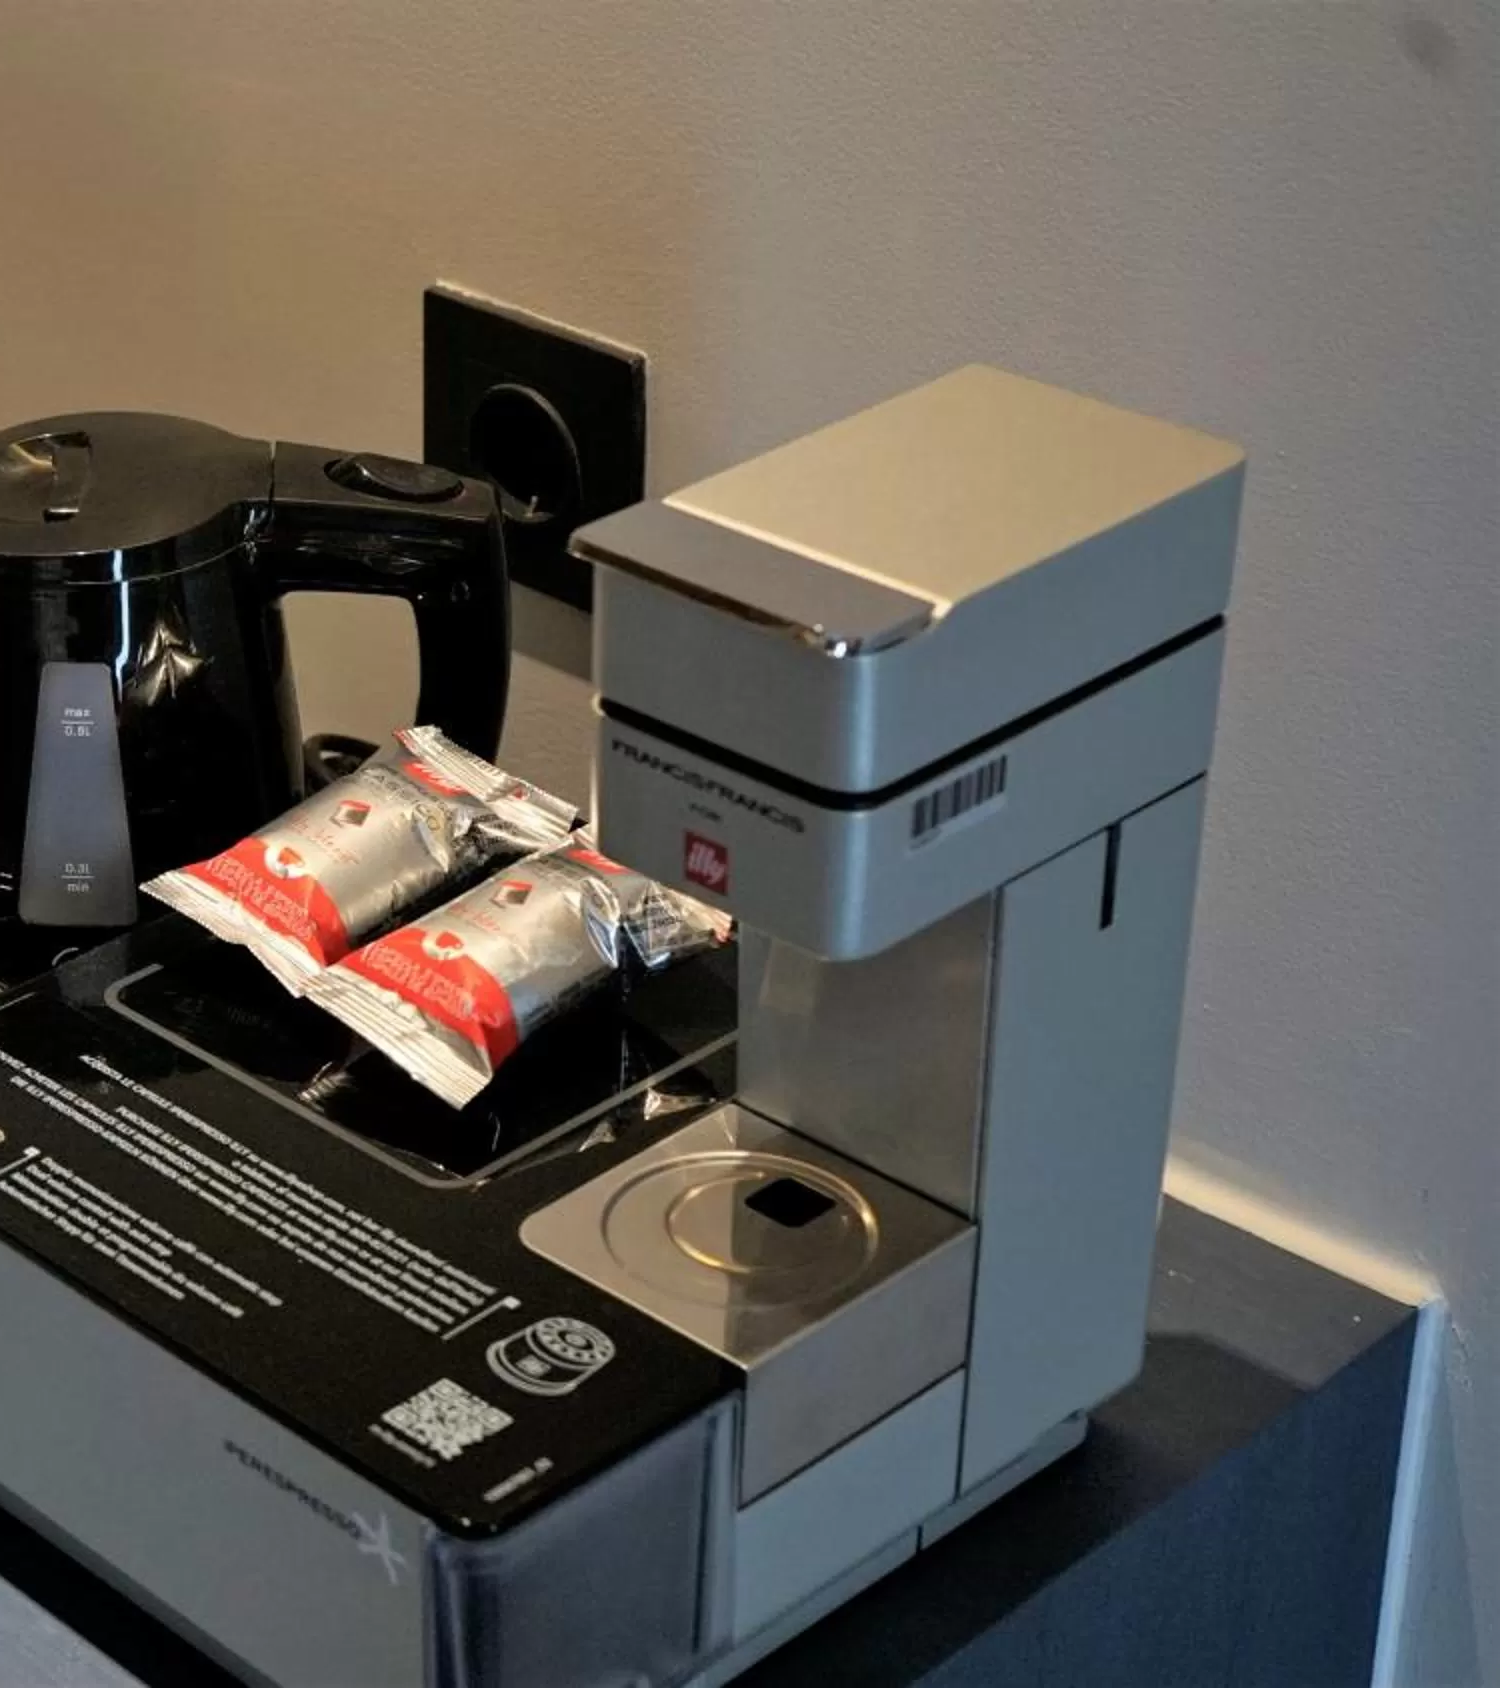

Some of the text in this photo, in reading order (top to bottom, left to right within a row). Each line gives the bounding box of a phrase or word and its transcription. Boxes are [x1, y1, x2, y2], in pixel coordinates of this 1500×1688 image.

[64, 707, 91, 717] max
[687, 839, 727, 886] illy
[67, 882, 90, 893] min
